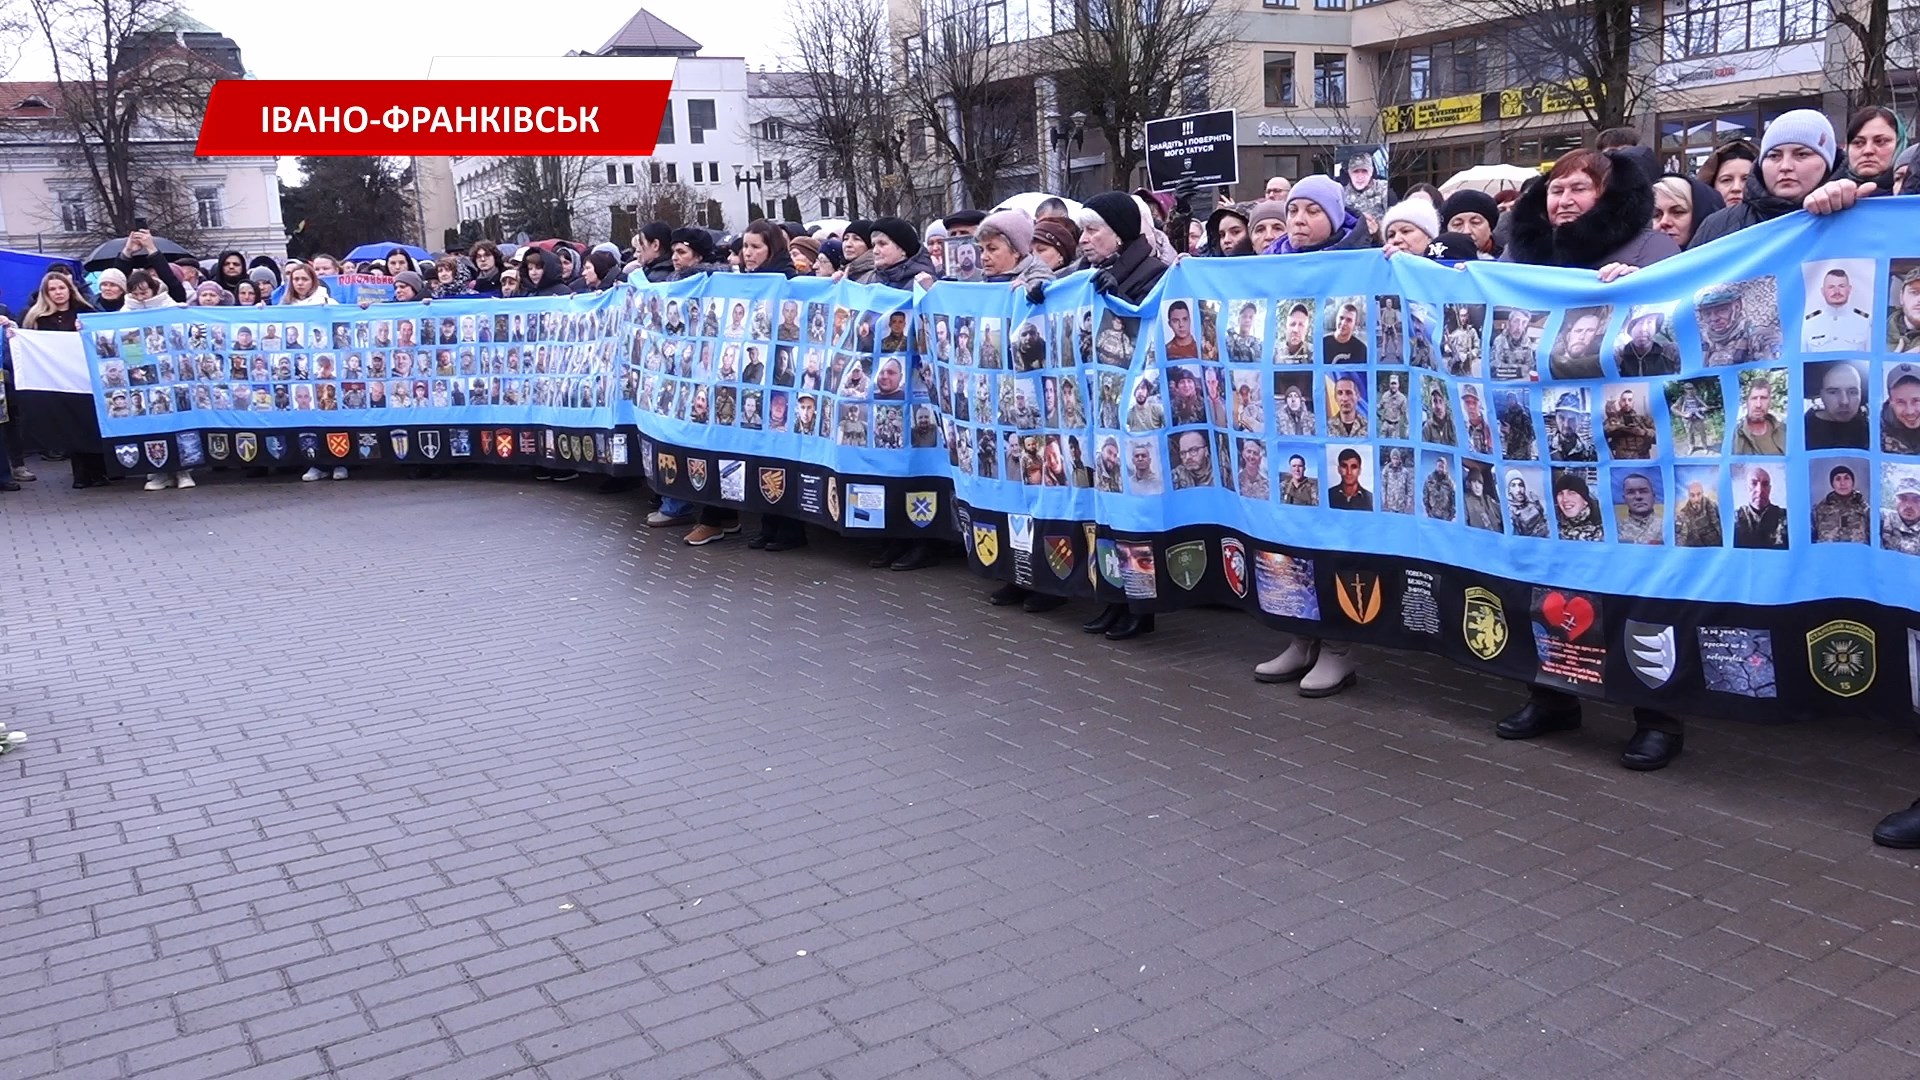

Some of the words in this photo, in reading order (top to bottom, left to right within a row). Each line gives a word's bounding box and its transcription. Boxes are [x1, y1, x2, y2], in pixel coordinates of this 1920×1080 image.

[1150, 139, 1183, 152] ЗНАЙДІТЬ
[1188, 133, 1232, 146] ПОВЕРНІТЬ
[1164, 148, 1185, 158] МОГО
[1186, 144, 1214, 155] ТАТУСЯ
[1840, 682, 1851, 690] 15
